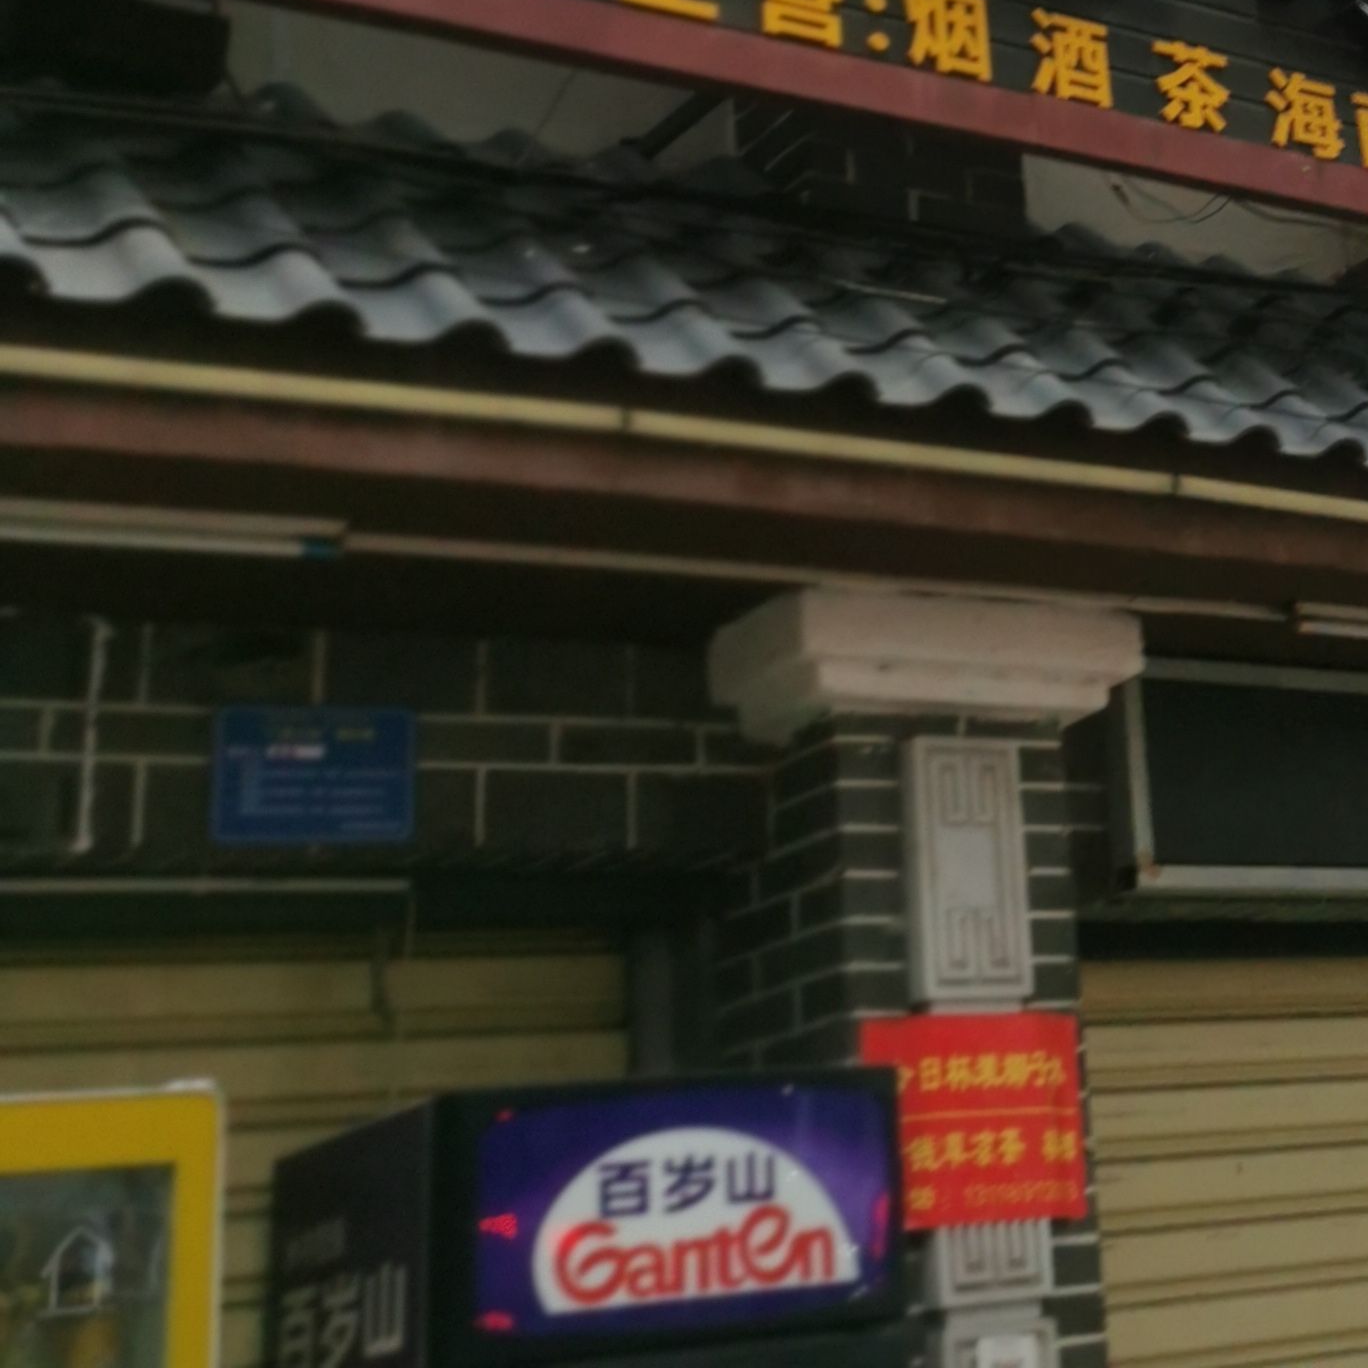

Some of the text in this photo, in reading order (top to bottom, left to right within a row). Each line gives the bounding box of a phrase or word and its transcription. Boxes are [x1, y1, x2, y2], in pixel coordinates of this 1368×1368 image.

[598, 1153, 776, 1218] 百岁山
[555, 1204, 835, 1306] Ganten
